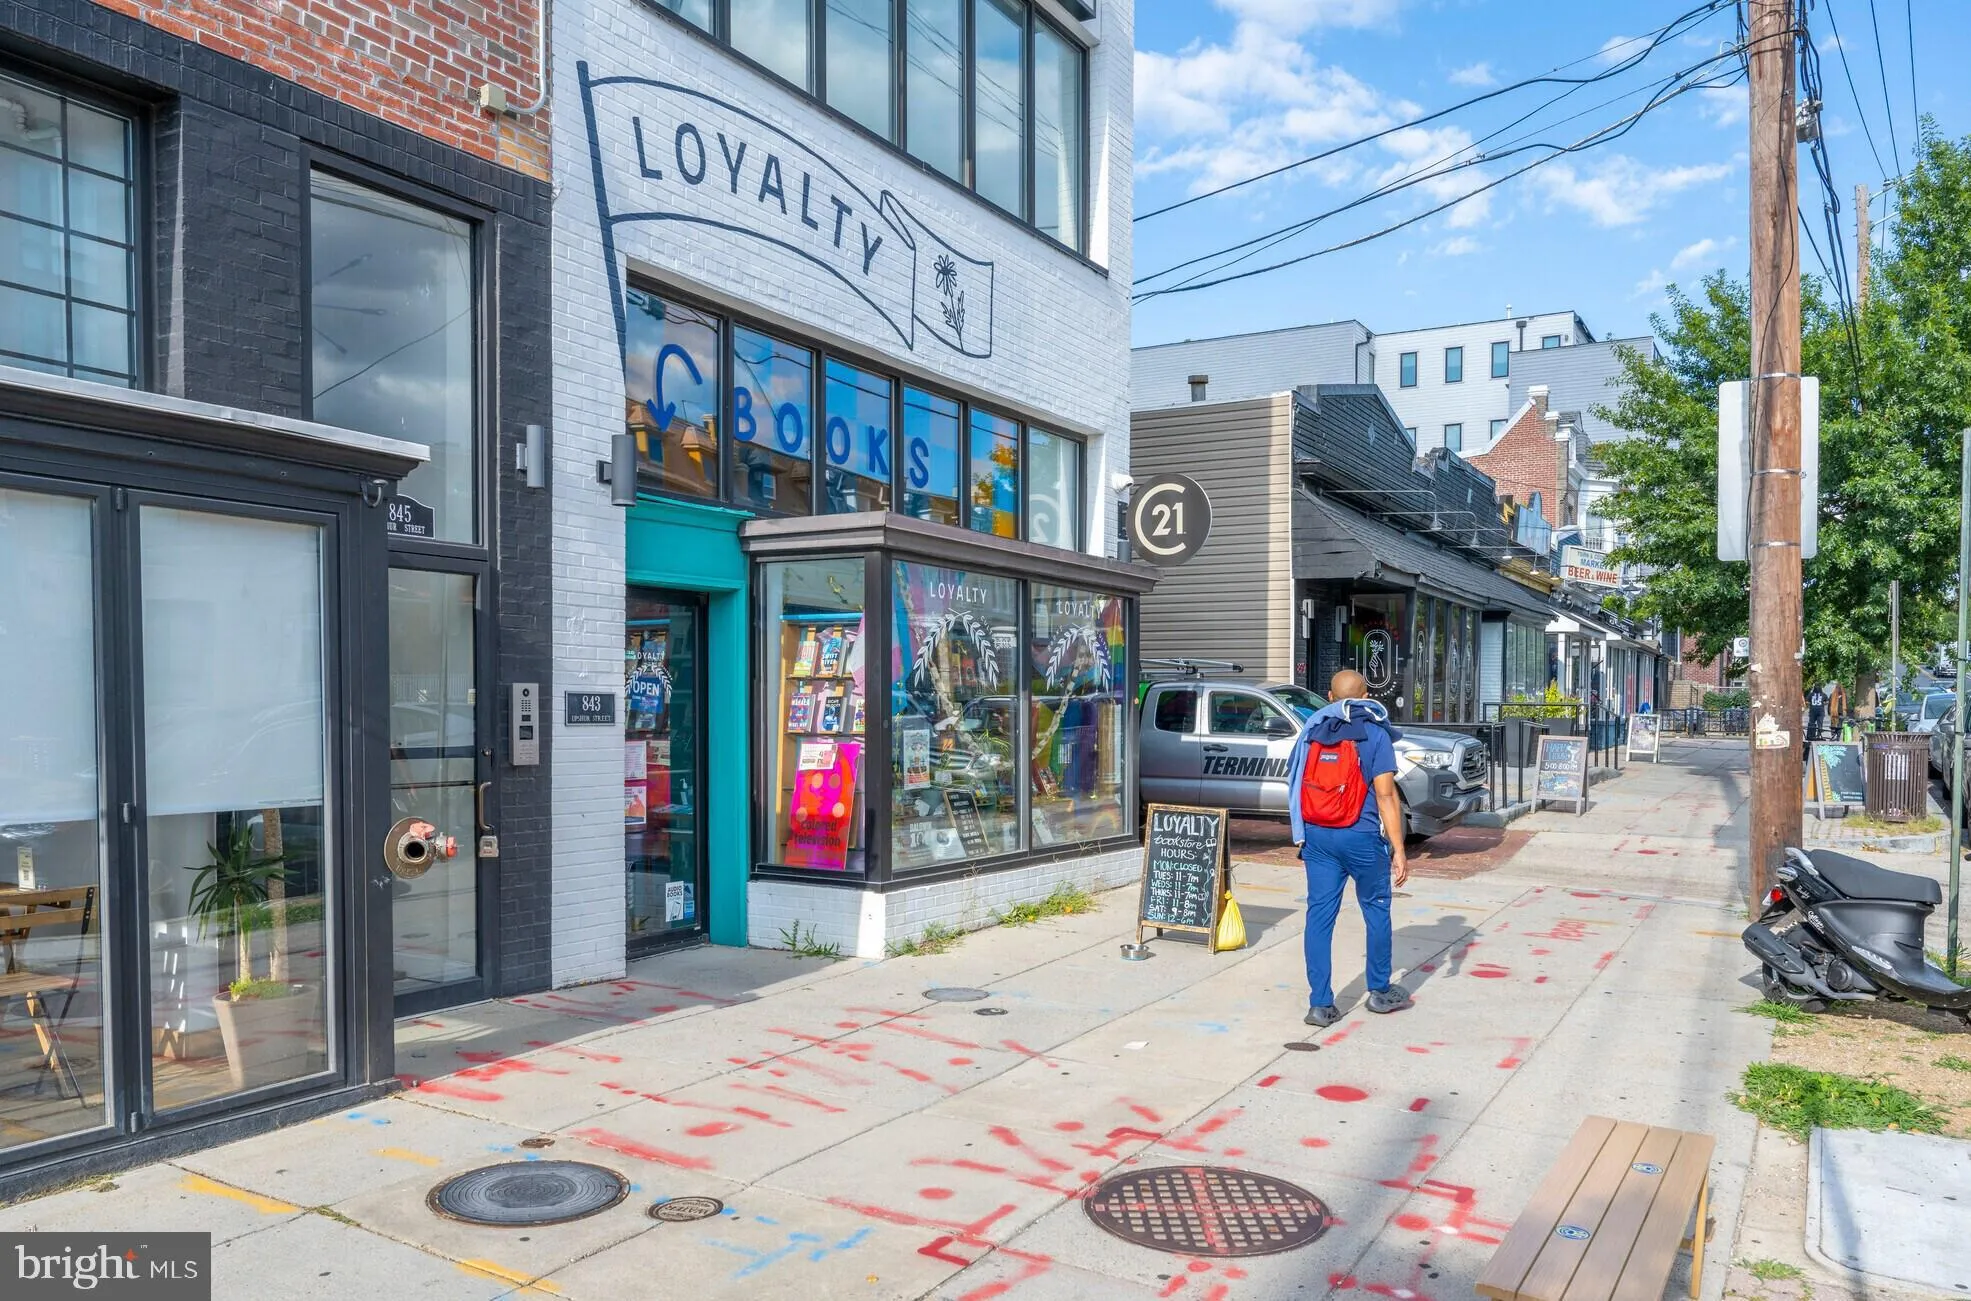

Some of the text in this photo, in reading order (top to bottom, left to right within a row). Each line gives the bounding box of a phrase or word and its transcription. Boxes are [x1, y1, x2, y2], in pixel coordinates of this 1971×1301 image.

[632, 116, 883, 276] LOYALTY
[733, 386, 930, 489] BOOKS
[389, 503, 412, 523] 845
[404, 523, 425, 534] STREET
[1568, 566, 1591, 579] BEER
[1596, 570, 1618, 584] WINE
[930, 582, 987, 604] LOYALTY
[1056, 600, 1101, 620] LOYALTY
[634, 650, 665, 660] OYALTY
[632, 680, 660, 697] OPEN
[582, 695, 601, 711] 843
[802, 819, 838, 832] colored
[1153, 813, 1219, 837] LOYALTY
[794, 833, 841, 848] television
[1154, 835, 1203, 850] bookstore
[1161, 848, 1197, 860] HOURS:
